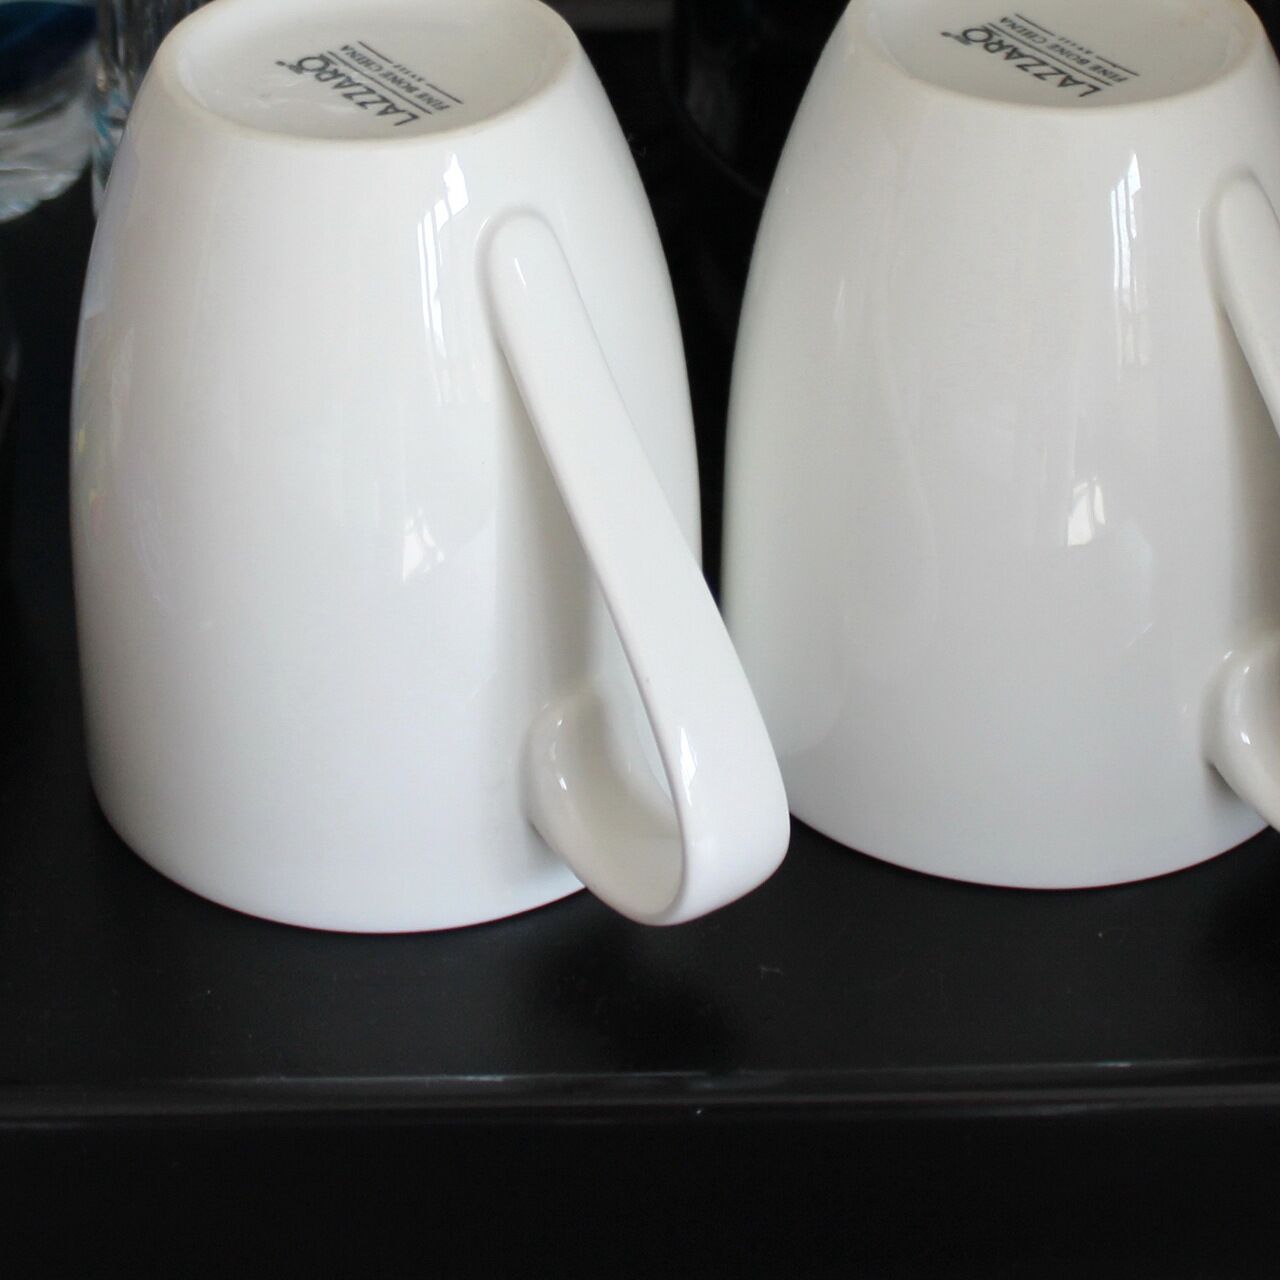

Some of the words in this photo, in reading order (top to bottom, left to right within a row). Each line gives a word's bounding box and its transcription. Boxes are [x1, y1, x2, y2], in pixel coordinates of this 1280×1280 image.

[1000, 16, 1049, 44] CHINA
[340, 44, 383, 72] CHINA
[962, 26, 1101, 97] LAZZARO
[1047, 44, 1091, 66] BONE
[1089, 64, 1128, 83] FINE
[297, 56, 419, 126] LAZZARO
